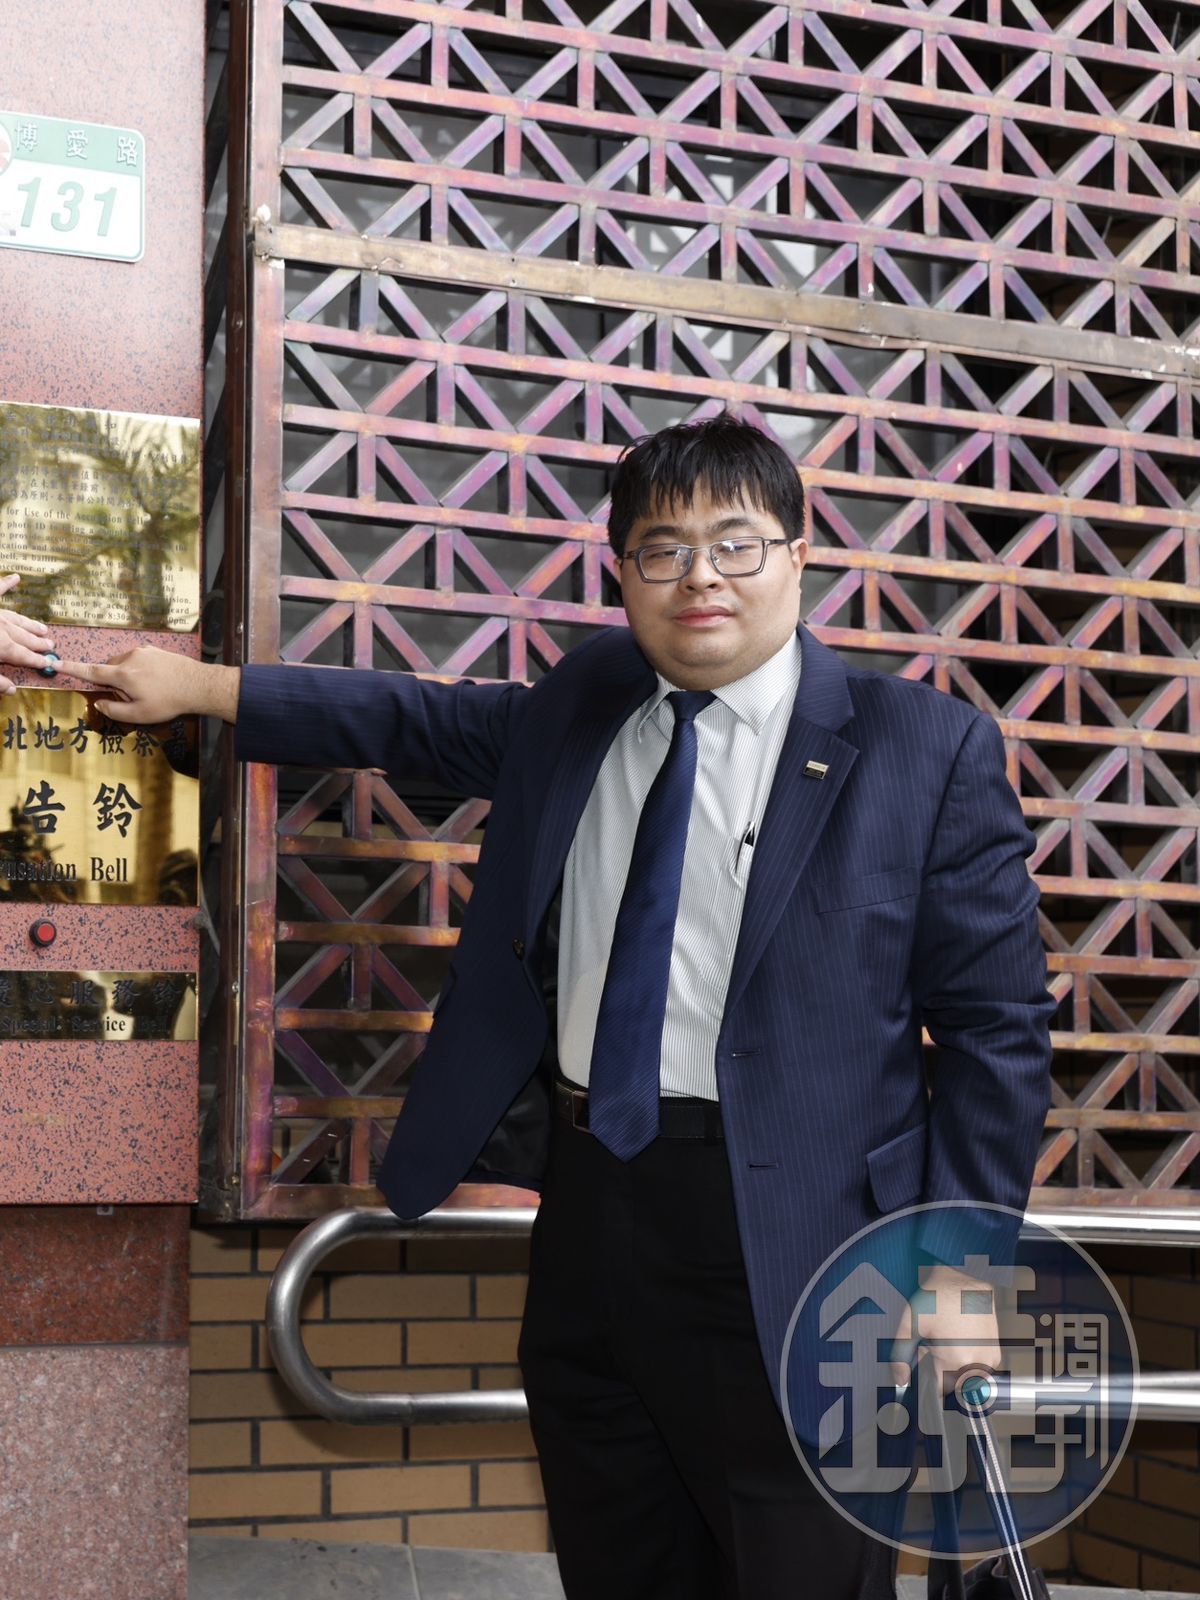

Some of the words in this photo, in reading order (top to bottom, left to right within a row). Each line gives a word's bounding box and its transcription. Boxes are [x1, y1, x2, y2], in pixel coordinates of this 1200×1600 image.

[15, 120, 137, 167] 博愛路
[17, 177, 117, 237] 131
[7, 506, 19, 517] for
[24, 508, 40, 518] Use
[44, 509, 54, 519] of
[57, 510, 70, 520] the
[75, 512, 122, 523] Accuion
[35, 521, 46, 530] ID
[108, 612, 137, 621] 8:30a
[164, 606, 190, 615] eard
[90, 856, 128, 882] Bell
